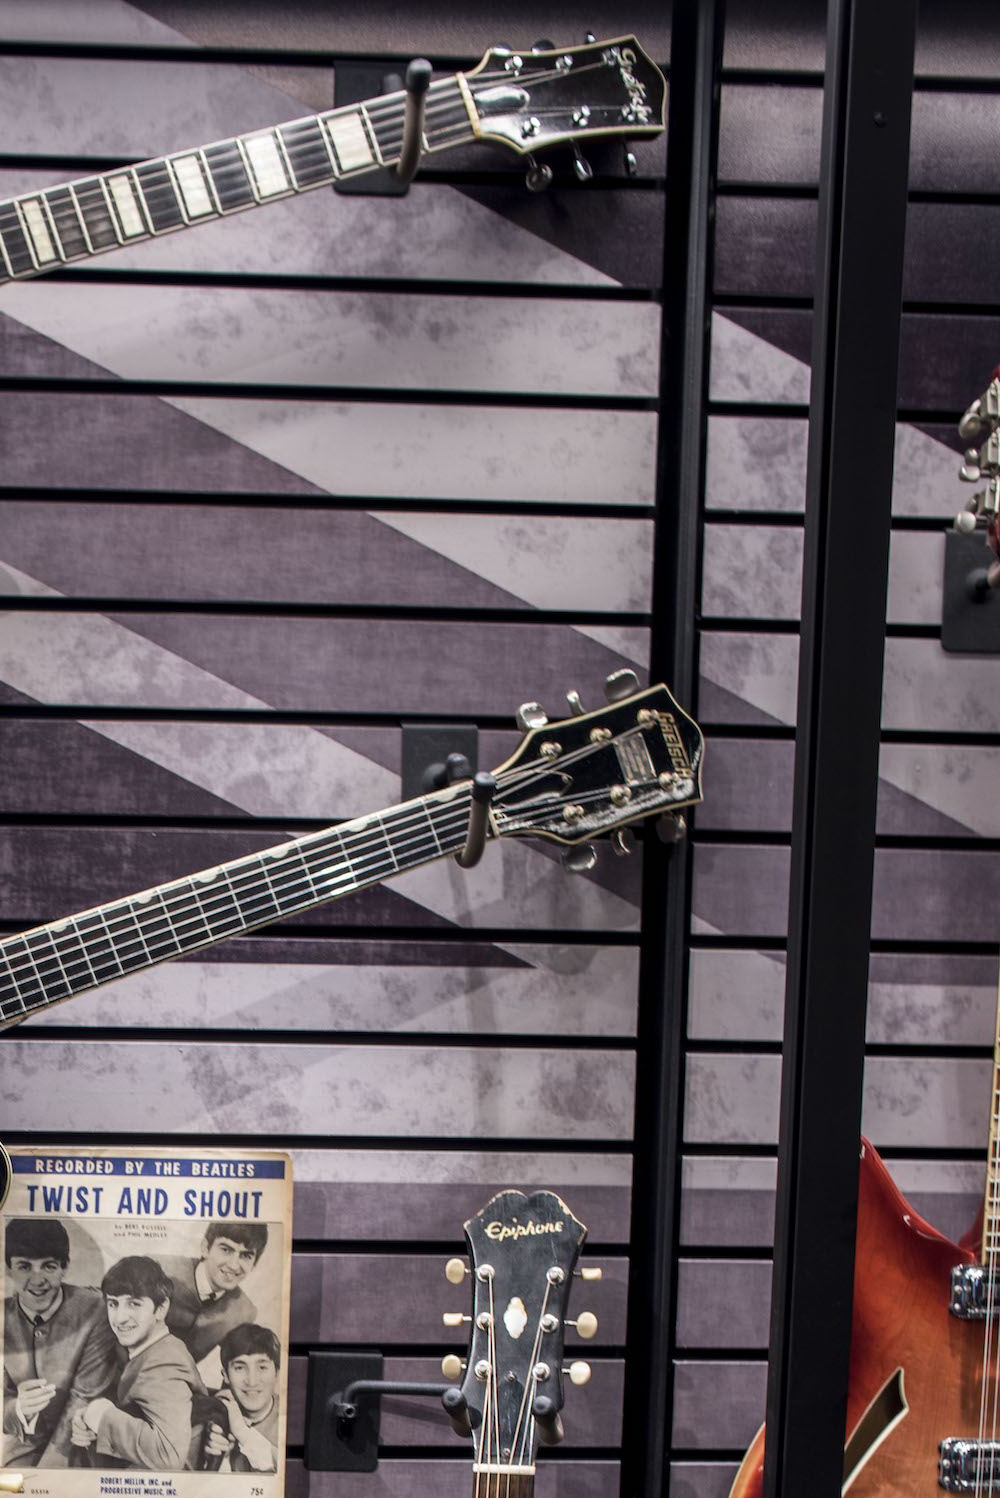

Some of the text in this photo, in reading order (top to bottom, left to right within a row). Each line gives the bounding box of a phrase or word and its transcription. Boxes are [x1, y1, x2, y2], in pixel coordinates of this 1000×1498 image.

[35, 1159, 255, 1177] RECORDED BY THE BEATLES
[27, 1185, 263, 1218] TWIST AND SHOUT
[484, 1217, 564, 1242] Epiphone
[100, 1477, 122, 1485] ROBERT
